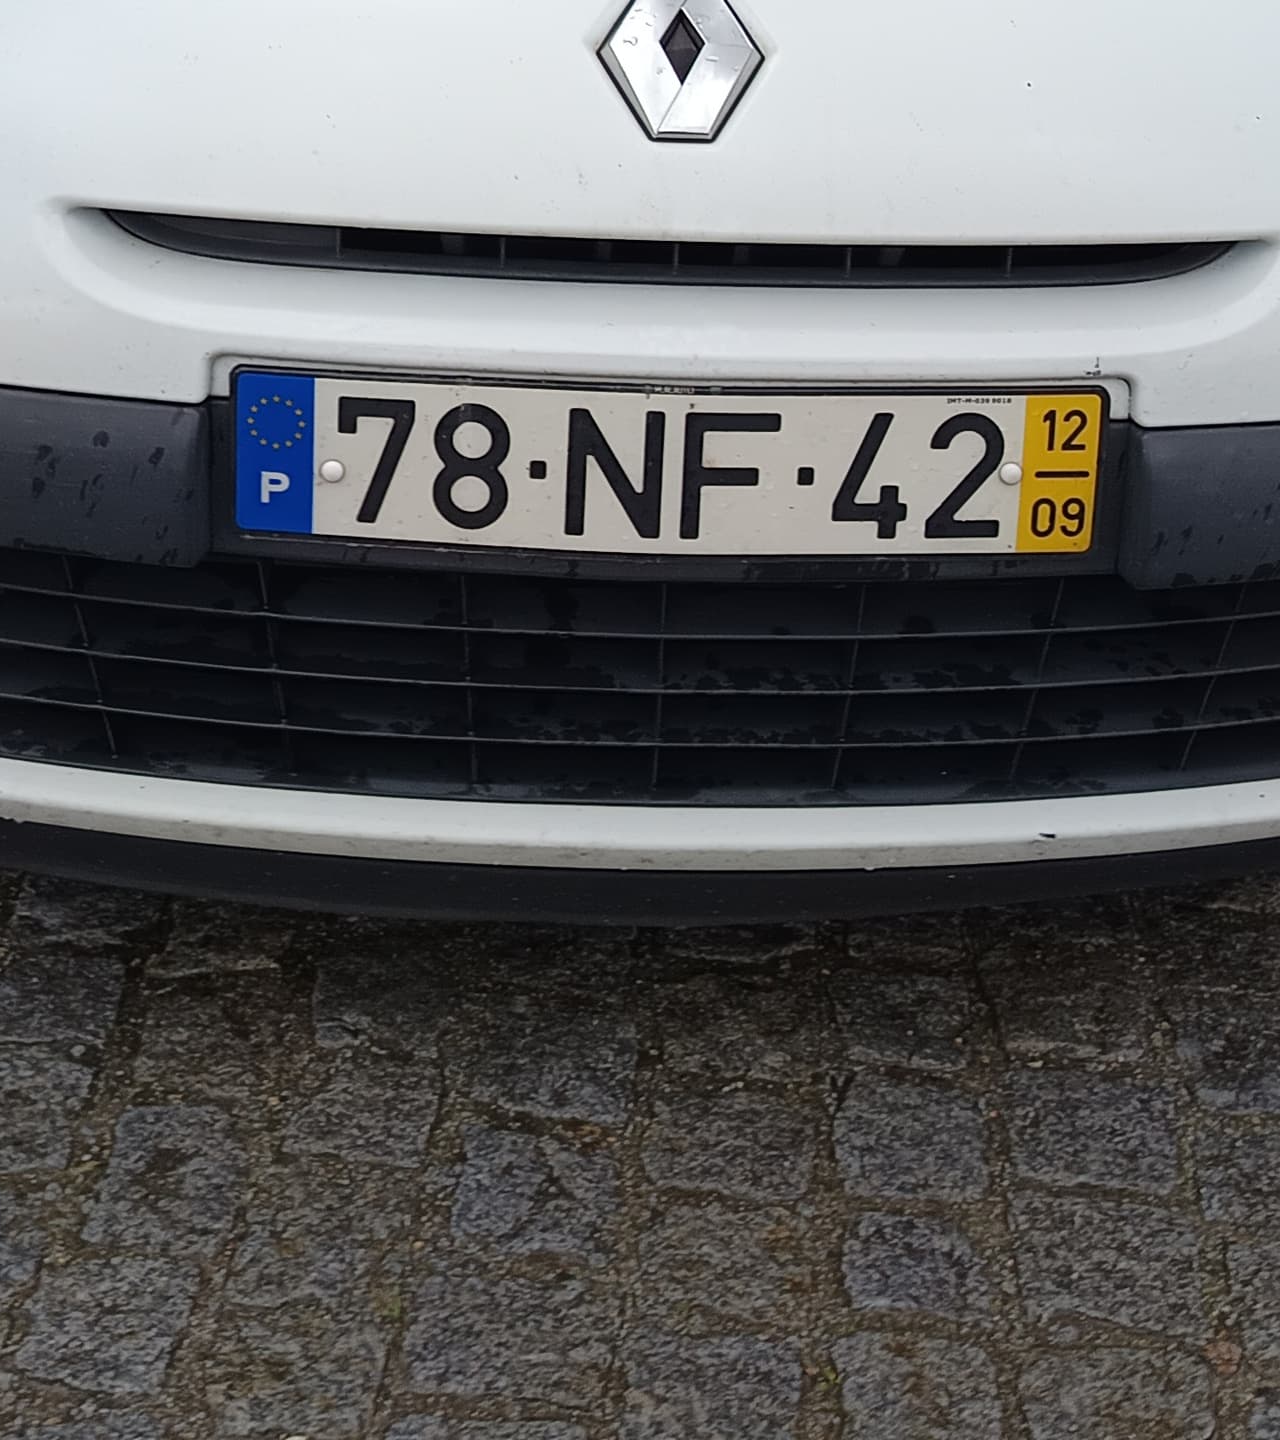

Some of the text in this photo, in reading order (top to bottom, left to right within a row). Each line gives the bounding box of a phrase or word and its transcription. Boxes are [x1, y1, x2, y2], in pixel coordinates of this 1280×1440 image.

[1043, 409, 1088, 452] 12
[260, 471, 291, 504] P
[1030, 497, 1086, 539] 09
